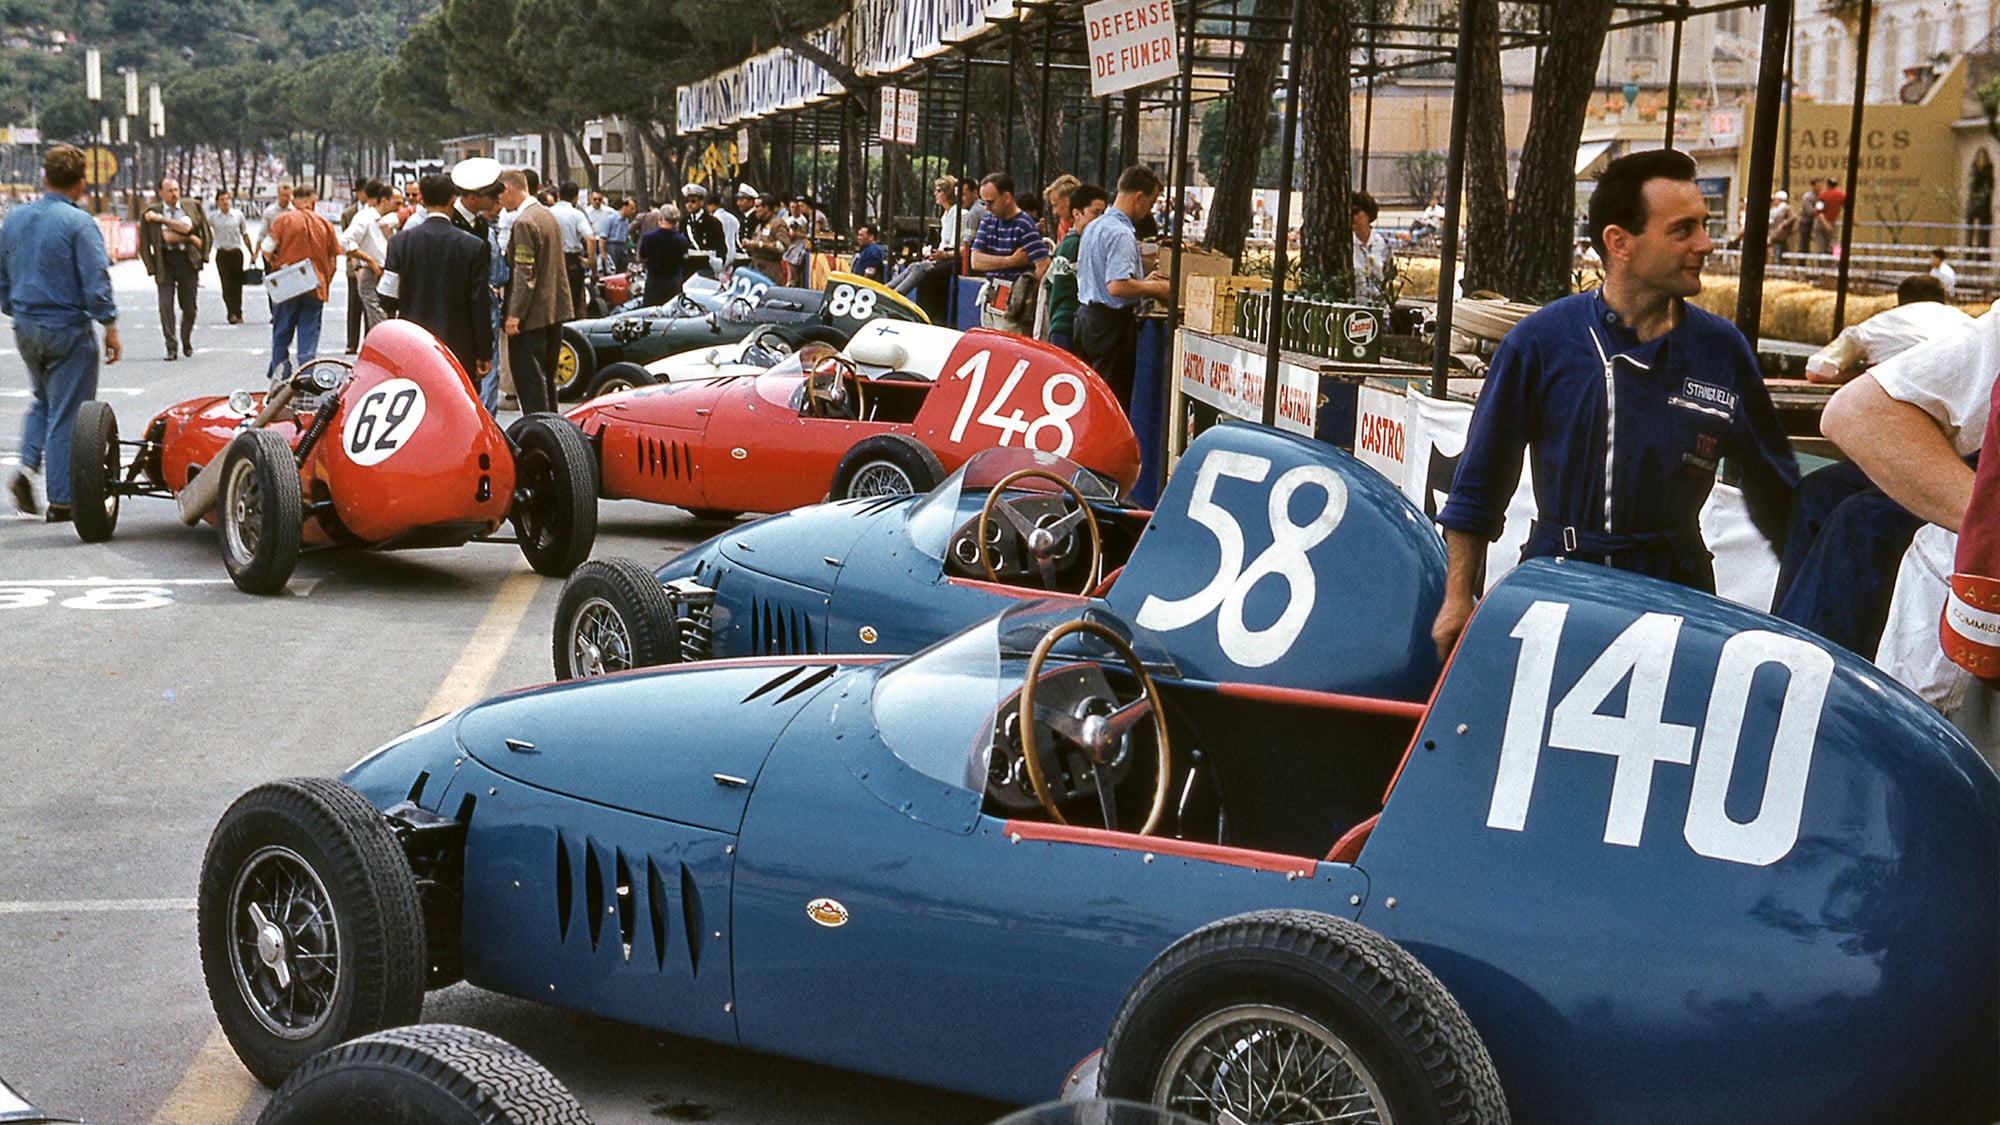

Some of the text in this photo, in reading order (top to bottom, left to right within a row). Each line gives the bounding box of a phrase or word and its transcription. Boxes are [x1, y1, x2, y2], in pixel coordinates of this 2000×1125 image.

[1090, 1, 1171, 42] DEFENSE
[1096, 37, 1172, 78] DE FUMER
[883, 90, 917, 107] DEENSE
[884, 108, 915, 122] ABOLUE
[1784, 128, 1910, 149] ABCS
[829, 284, 877, 320] 88
[950, 349, 1087, 460] 148
[1242, 371, 1264, 407] CASTR
[1279, 384, 1312, 427] CASTROL
[351, 388, 417, 454] 62
[1135, 449, 1348, 668] 58
[1485, 600, 1836, 867] 140
